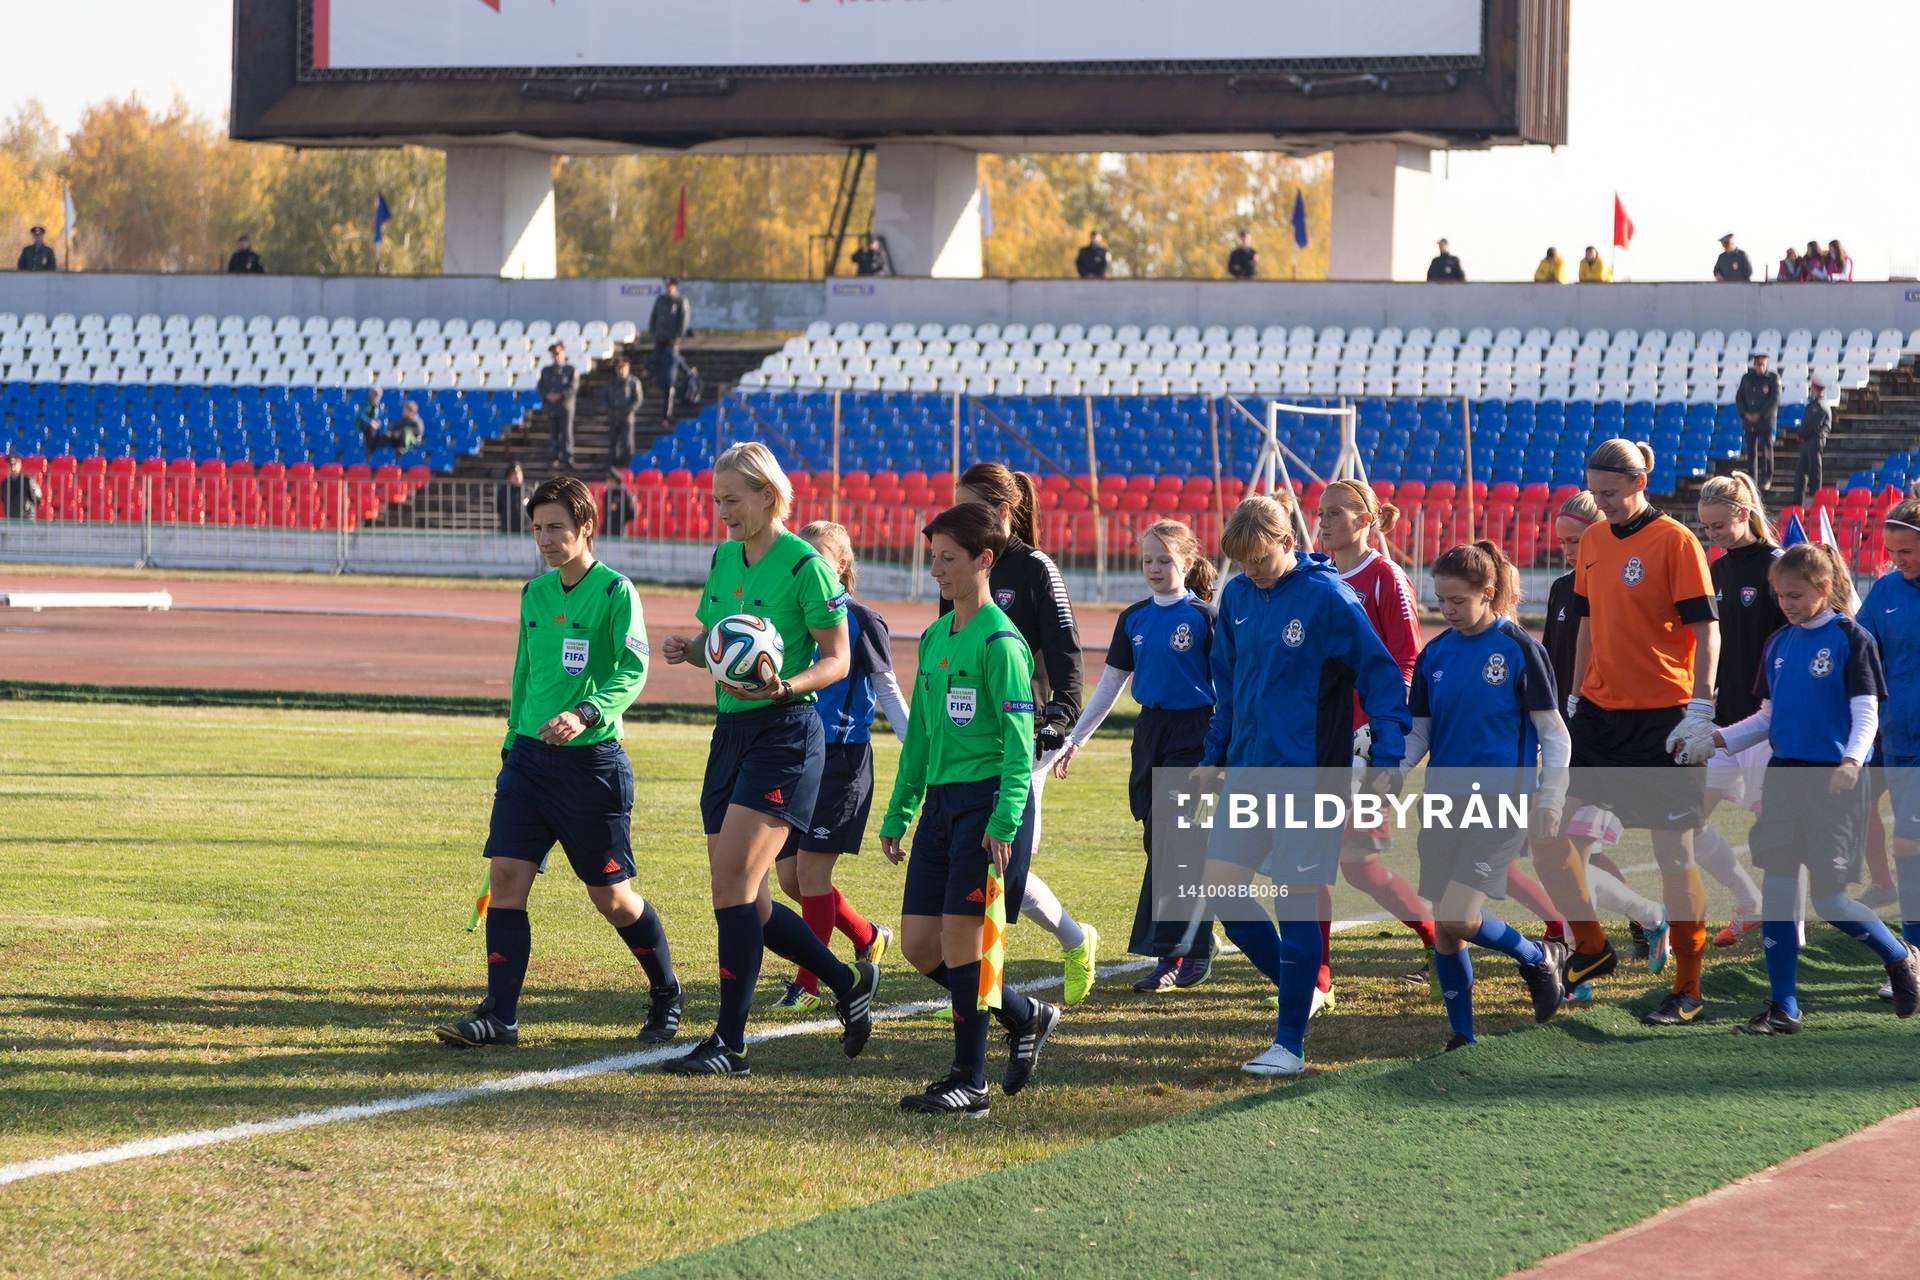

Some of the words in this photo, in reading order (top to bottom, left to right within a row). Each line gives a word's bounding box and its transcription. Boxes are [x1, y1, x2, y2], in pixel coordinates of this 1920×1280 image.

[564, 652, 585, 662] FIFA
[950, 702, 973, 712] FIFA
[1012, 702, 1034, 710] RESPECT
